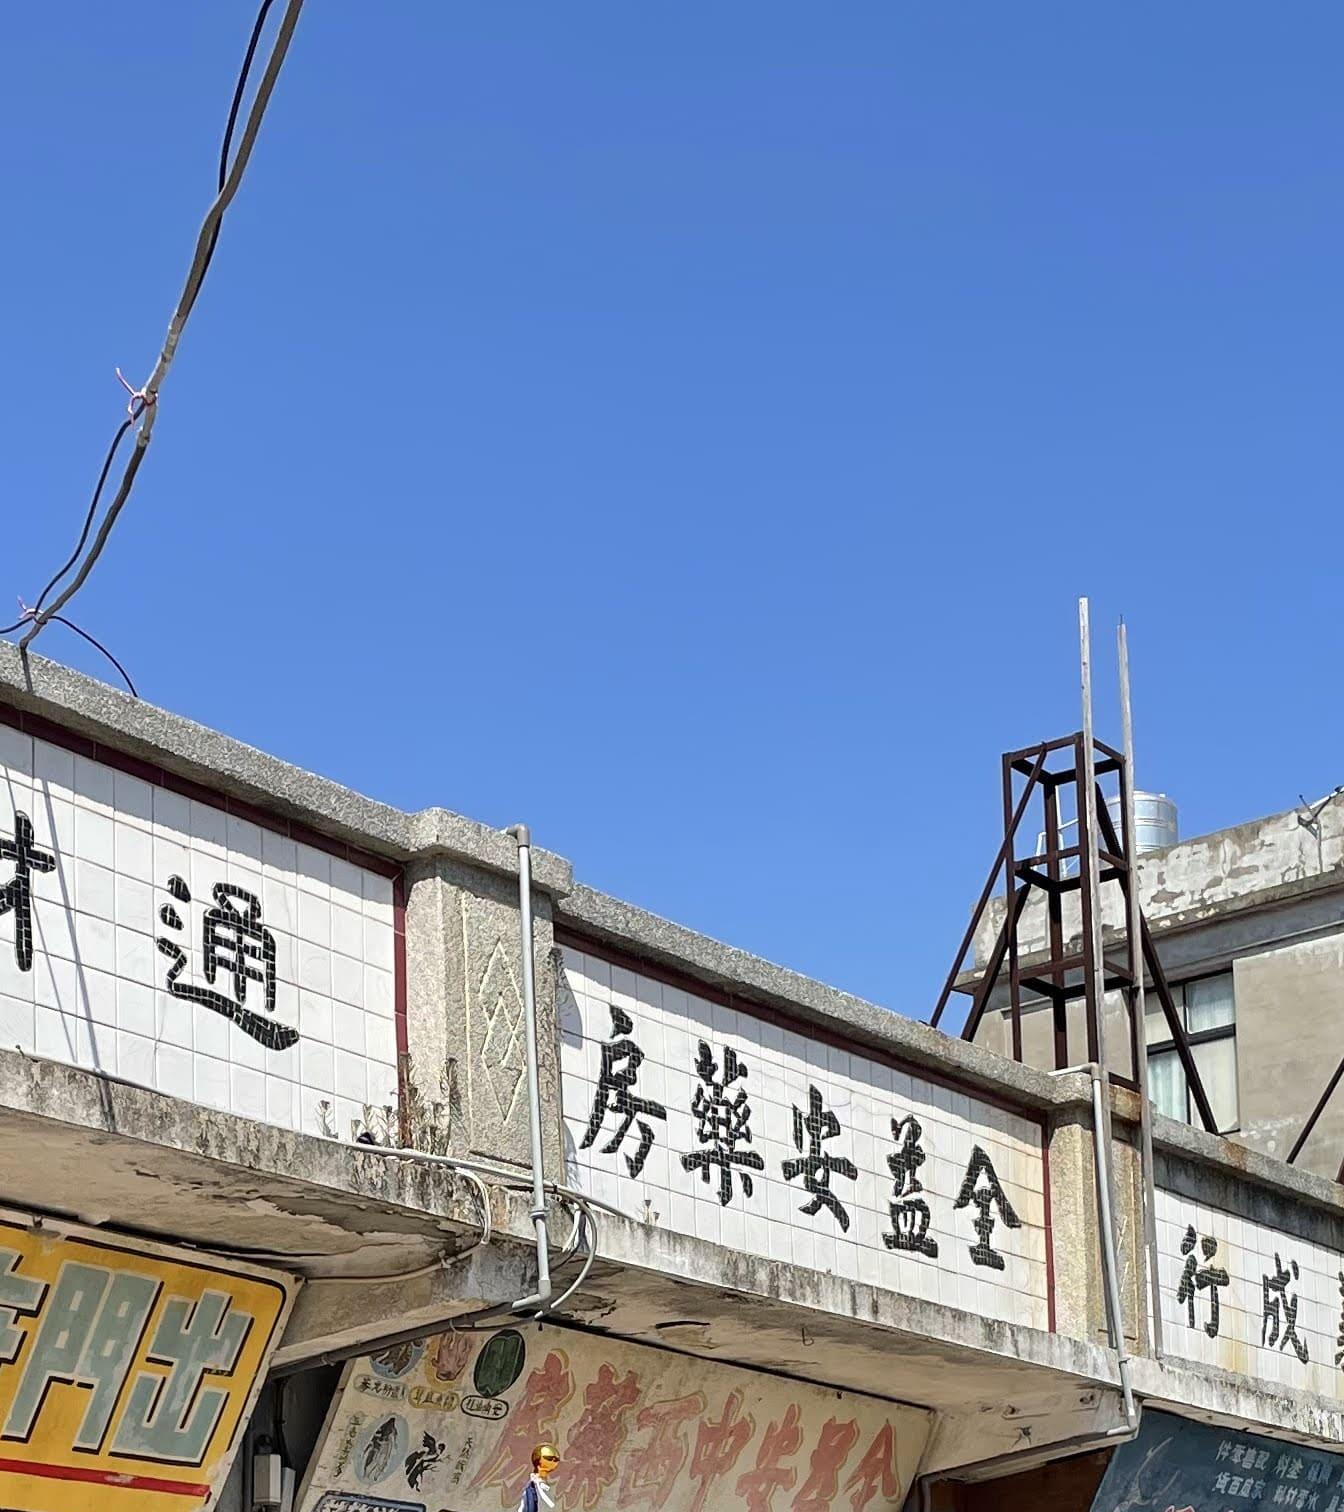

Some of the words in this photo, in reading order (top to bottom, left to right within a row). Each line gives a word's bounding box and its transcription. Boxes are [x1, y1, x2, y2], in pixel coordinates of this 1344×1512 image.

[579, 1005, 1022, 1273] 全益安藥房
